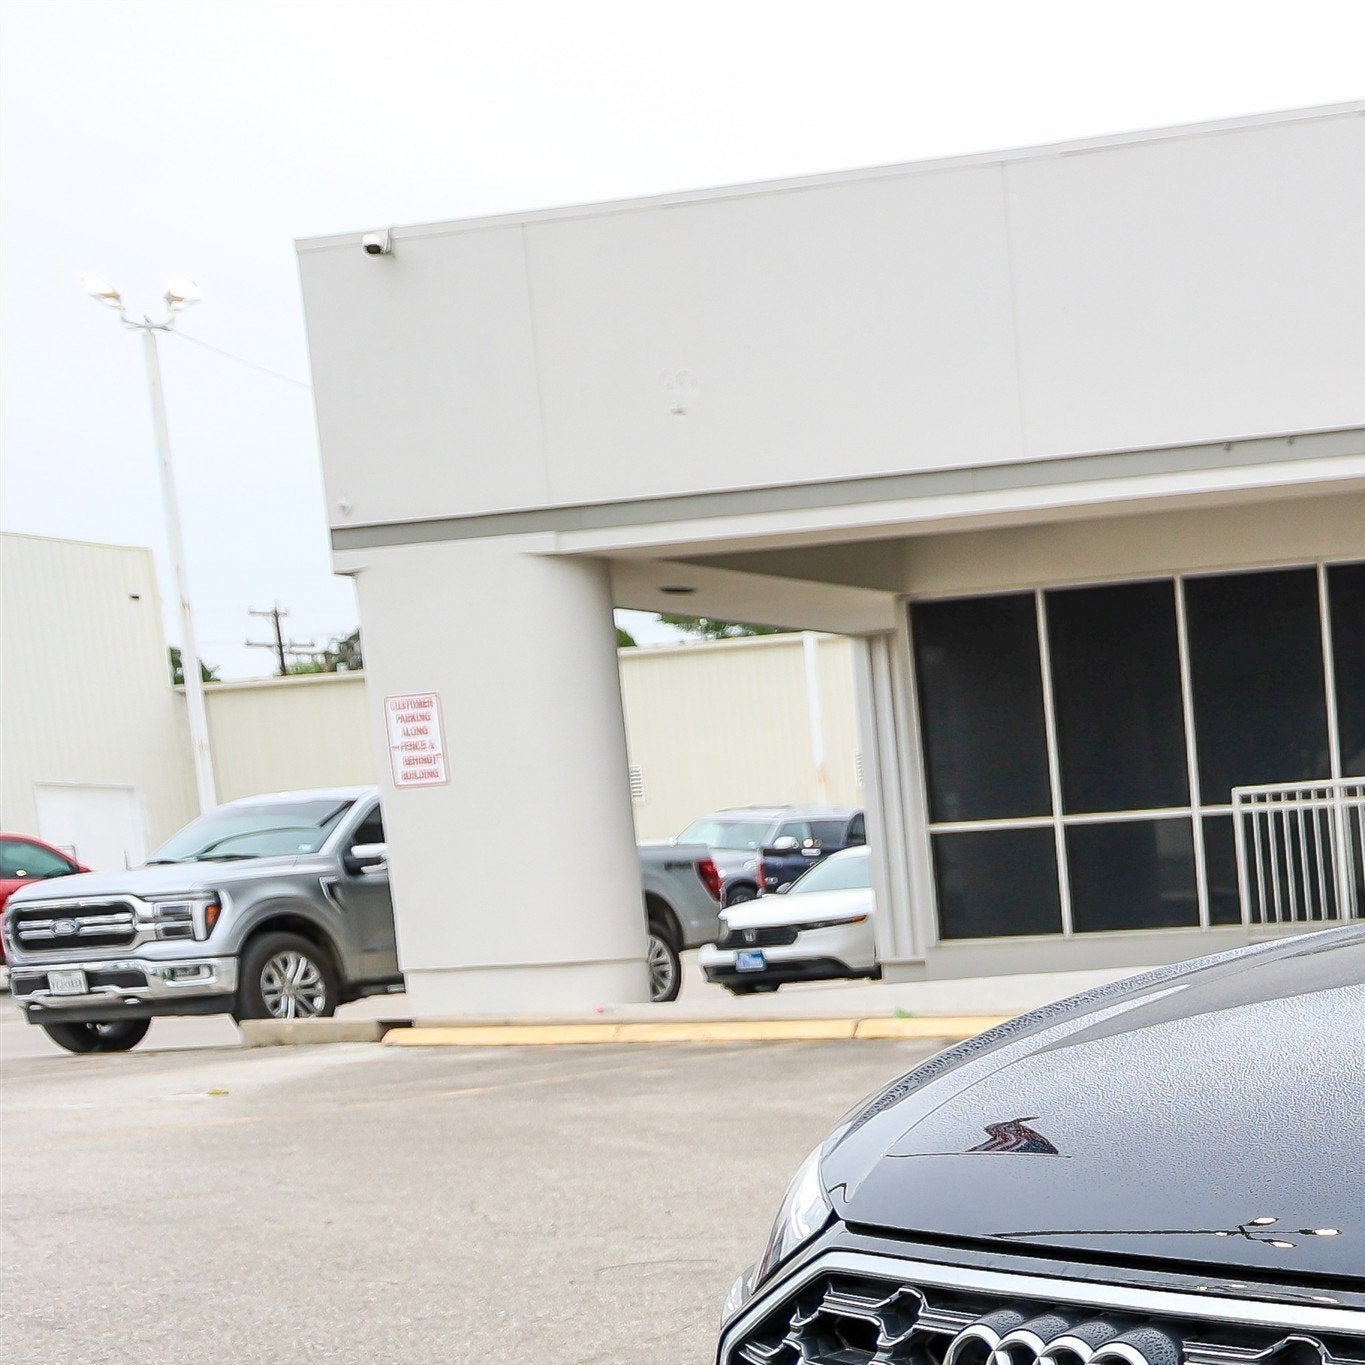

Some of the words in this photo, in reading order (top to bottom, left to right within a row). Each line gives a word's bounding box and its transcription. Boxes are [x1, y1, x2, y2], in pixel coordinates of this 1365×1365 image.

[390, 698, 433, 711] CUSTOMER
[396, 713, 432, 724] PARKING
[402, 726, 429, 737] ALONG
[402, 769, 439, 780] BUILDING
